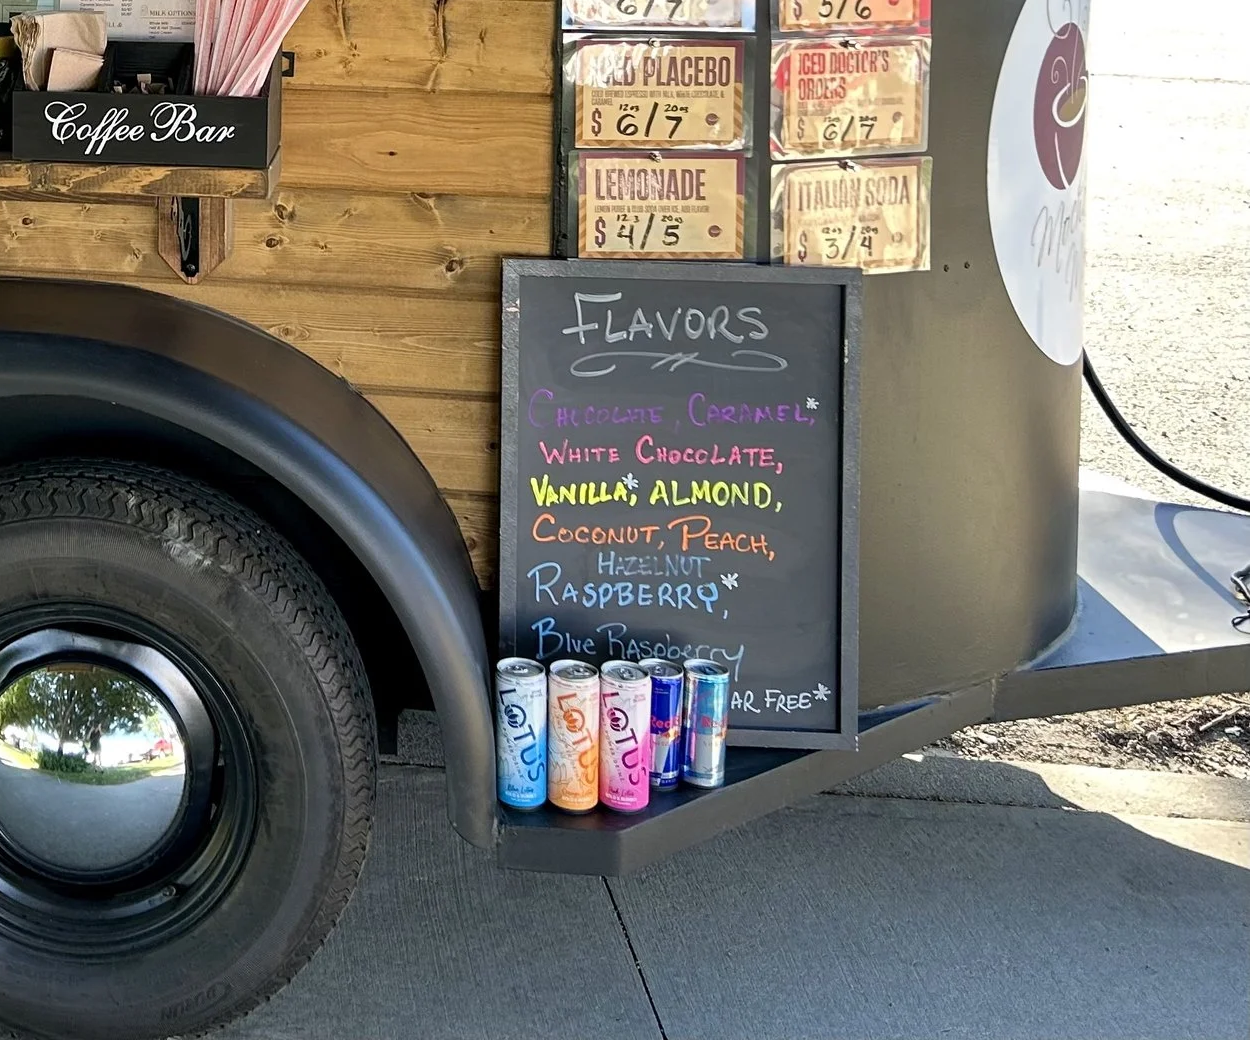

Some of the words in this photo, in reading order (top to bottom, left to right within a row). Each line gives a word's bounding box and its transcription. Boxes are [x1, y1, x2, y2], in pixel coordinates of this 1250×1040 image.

[643, 57, 731, 87] PLACEBO
[798, 53, 825, 76] ICED
[829, 50, 889, 75] DOCTOR'S
[45, 101, 145, 155] Coffee
[150, 102, 236, 143] Bar
[591, 108, 602, 137] $
[595, 168, 706, 201] LEMONADE
[799, 176, 861, 211] ITALIAN
[866, 175, 910, 206] SODA
[595, 216, 606, 248] $
[562, 292, 769, 344] FLAVORS
[539, 439, 620, 464] WHITE
[636, 434, 783, 474] CHOCOLATE,
[650, 479, 783, 512] ALMOND,
[532, 514, 665, 549] COCONUT,
[667, 515, 776, 561] PEACH,
[598, 552, 711, 577] HAZELNUT
[500, 688, 545, 782] LOTUS
[557, 692, 597, 785] LOTUS
[601, 692, 647, 785] LOTUS
